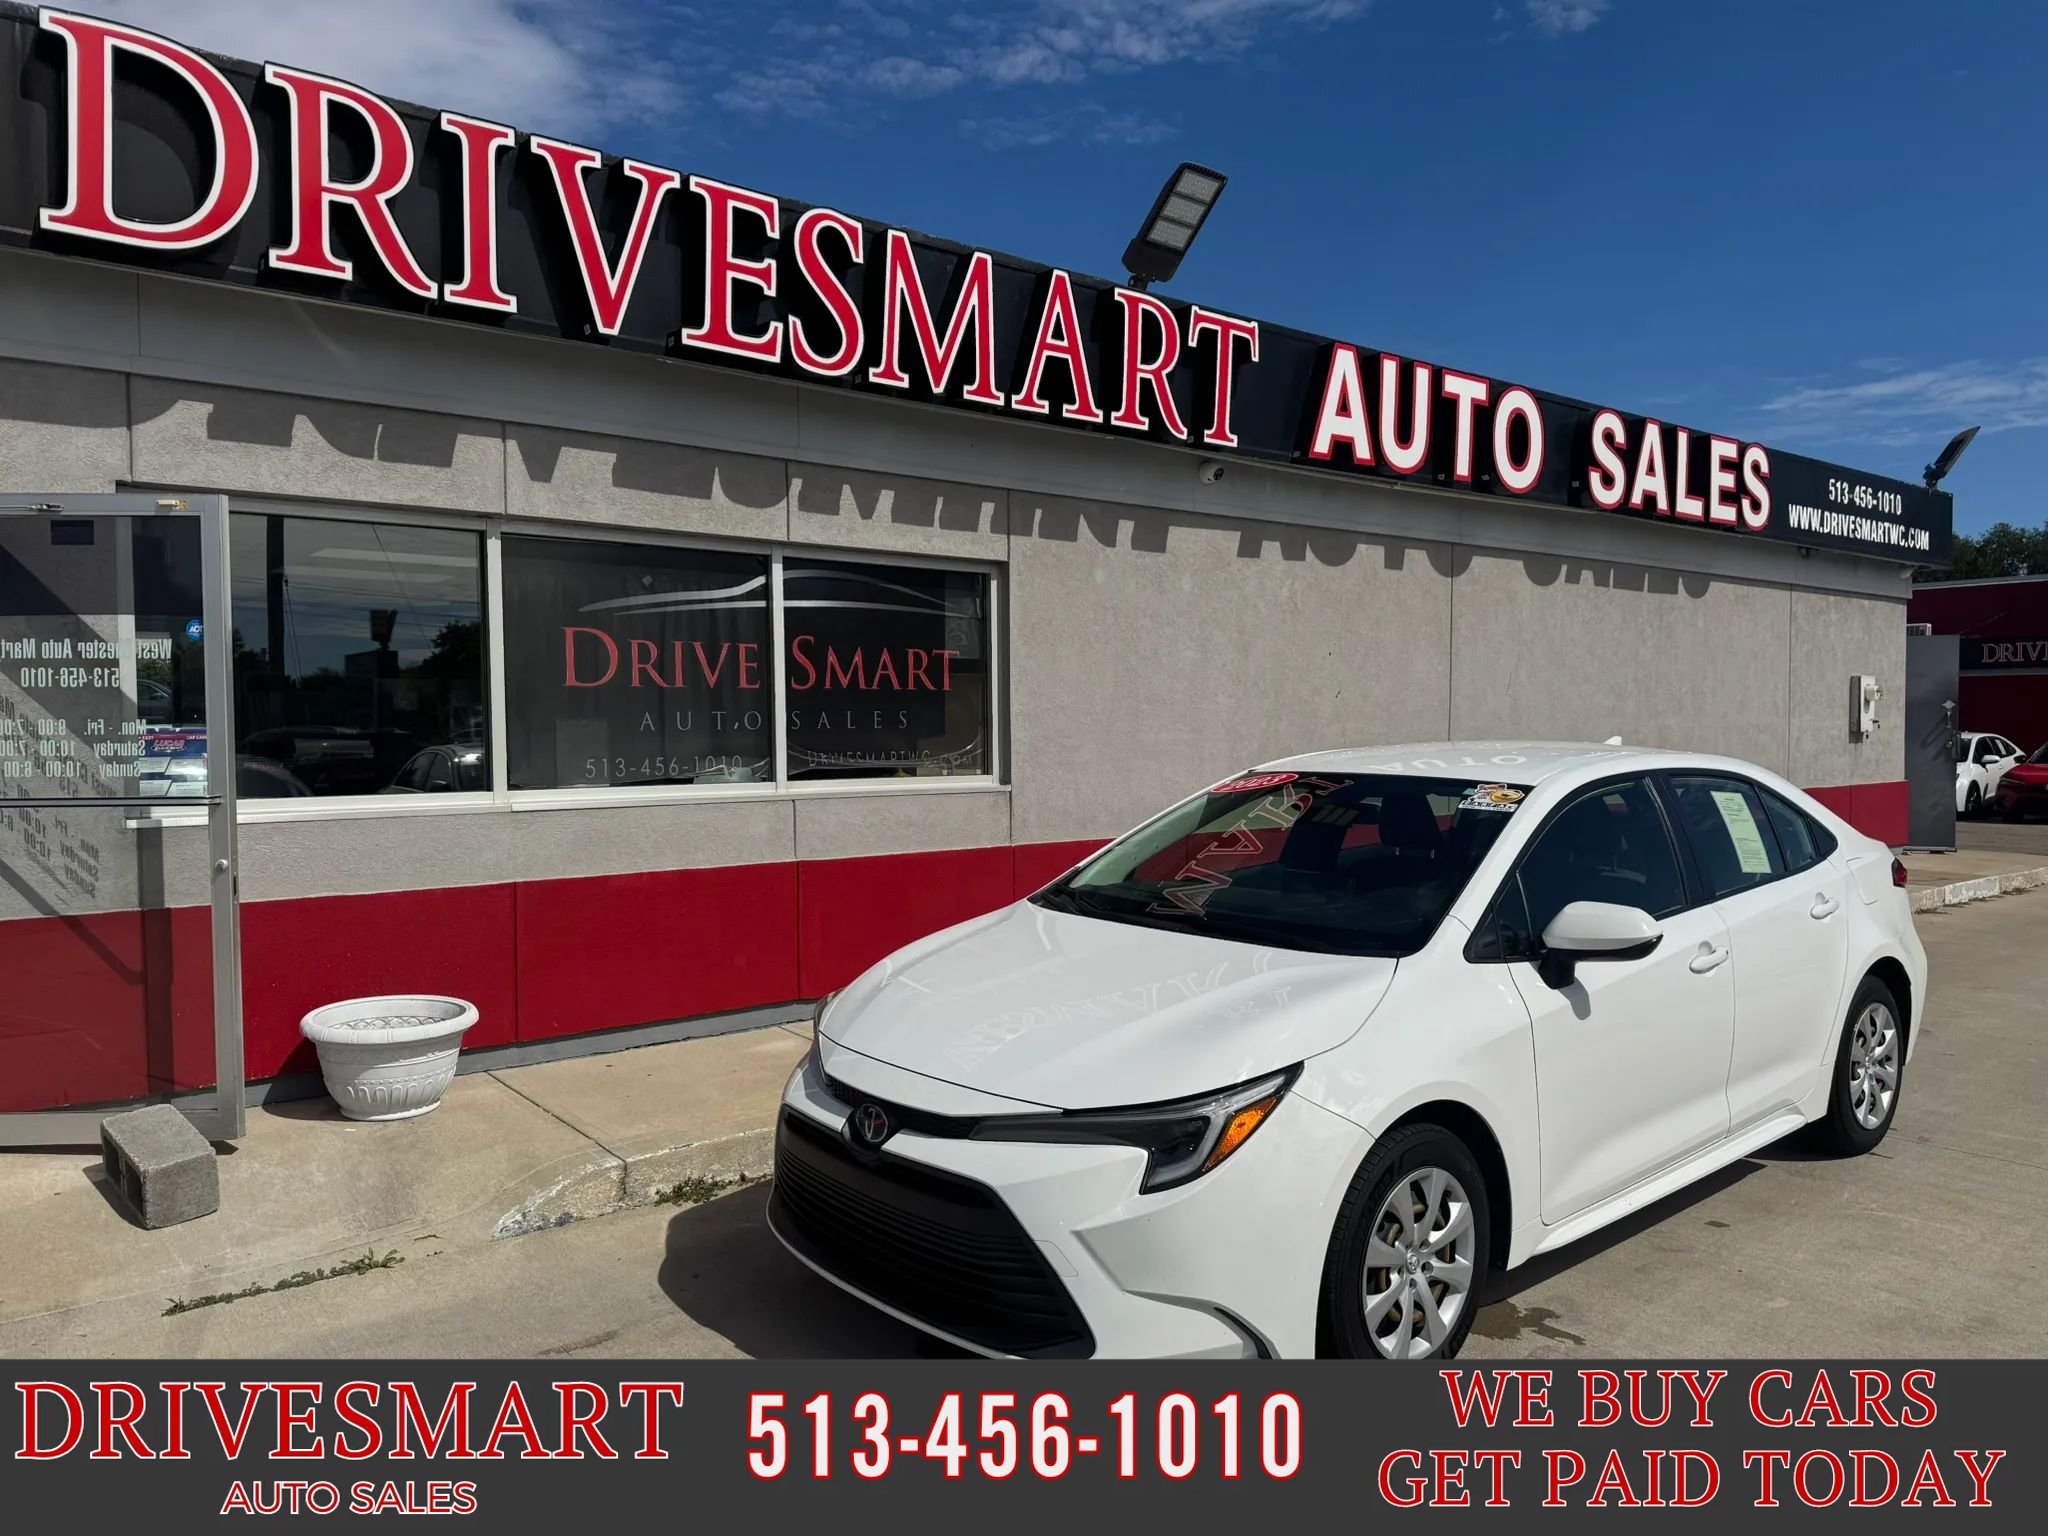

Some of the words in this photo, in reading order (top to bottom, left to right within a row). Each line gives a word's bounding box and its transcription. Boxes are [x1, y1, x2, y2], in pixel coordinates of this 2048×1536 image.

[38, 5, 1259, 448] DRIVESMART
[1308, 341, 1545, 495] AUTO
[1587, 408, 1772, 532] SALES
[1828, 478, 1902, 516] 513-456-1010
[1788, 503, 1930, 551] WWW.DRIVESMARTWC.COM
[561, 626, 761, 690] DRIVE
[791, 634, 961, 692] SMART
[639, 711, 762, 732] AUTO
[791, 710, 909, 730] SALES
[585, 754, 743, 779] 513-456-1010
